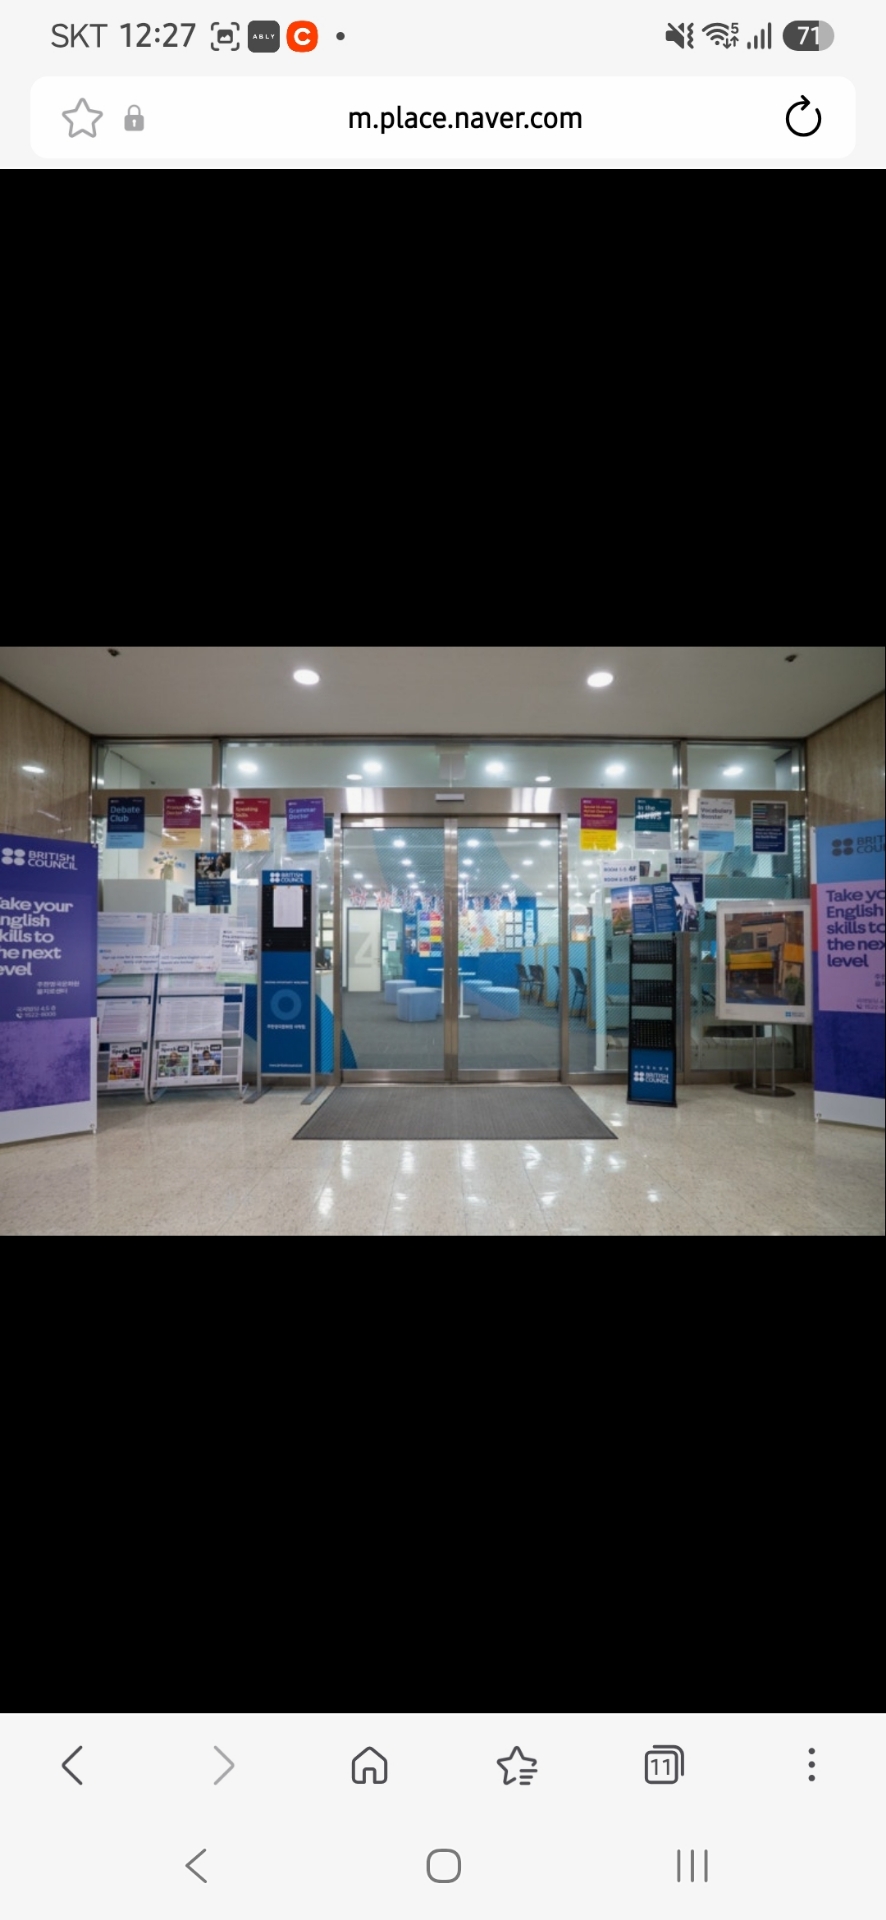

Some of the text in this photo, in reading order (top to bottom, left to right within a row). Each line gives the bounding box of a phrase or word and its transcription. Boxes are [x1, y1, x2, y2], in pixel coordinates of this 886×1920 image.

[51, 23, 196, 48] SKT 12:27
[797, 27, 820, 45] 71
[348, 105, 583, 134] m.place.naver.com
[110, 806, 141, 814] Debate
[637, 811, 662, 820] News
[701, 807, 733, 815] Vocabulary
[856, 835, 885, 846] BRIT
[28, 850, 76, 863] BRITISH
[27, 858, 78, 870] COUNCIL
[826, 889, 885, 904] Take yo
[33, 901, 74, 914] your
[826, 903, 884, 920] English
[0, 913, 50, 929] nglish
[826, 921, 866, 934] skills
[0, 928, 55, 944] kills to
[827, 938, 855, 951] the
[0, 946, 62, 960] he next
[827, 953, 869, 968] level
[650, 1758, 670, 1776] 11
